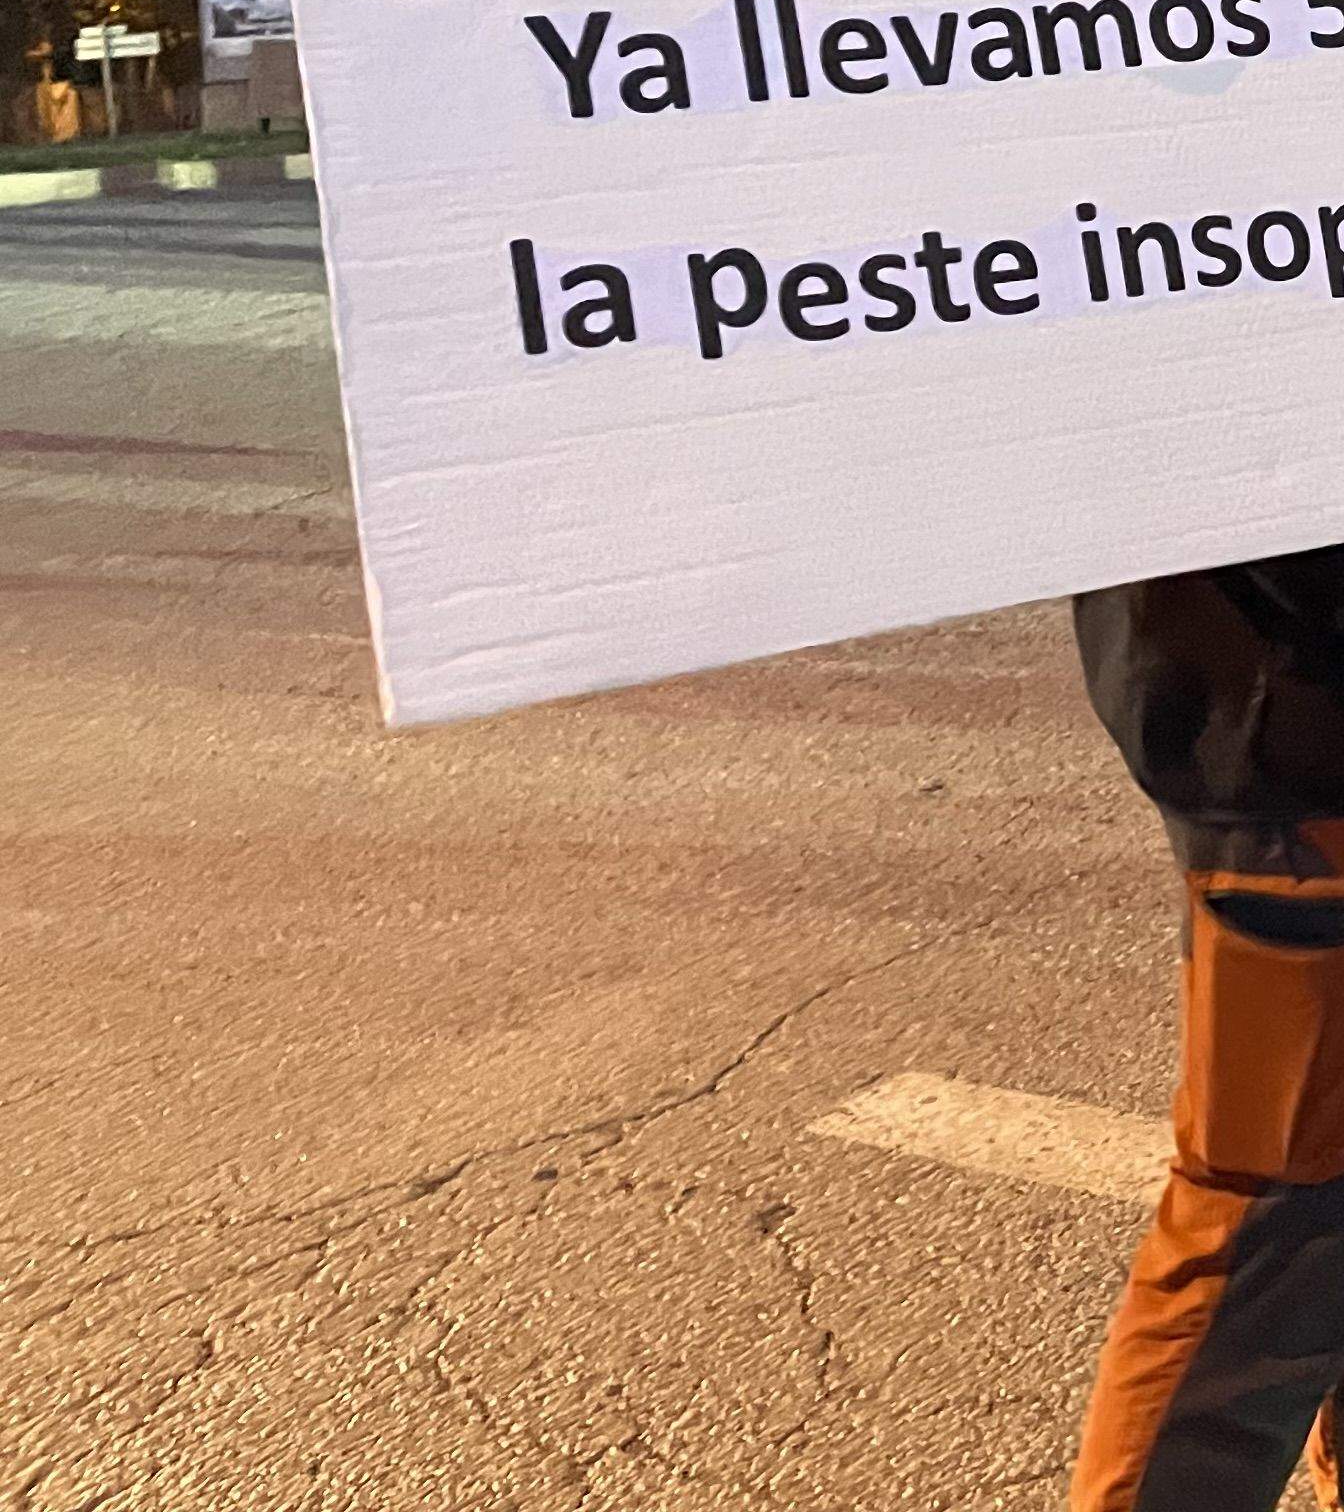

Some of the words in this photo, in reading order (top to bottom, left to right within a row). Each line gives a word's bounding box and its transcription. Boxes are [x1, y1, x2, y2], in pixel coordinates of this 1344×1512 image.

[524, 12, 690, 118] Ya
[510, 239, 636, 355] la
[688, 232, 1039, 359] peste
